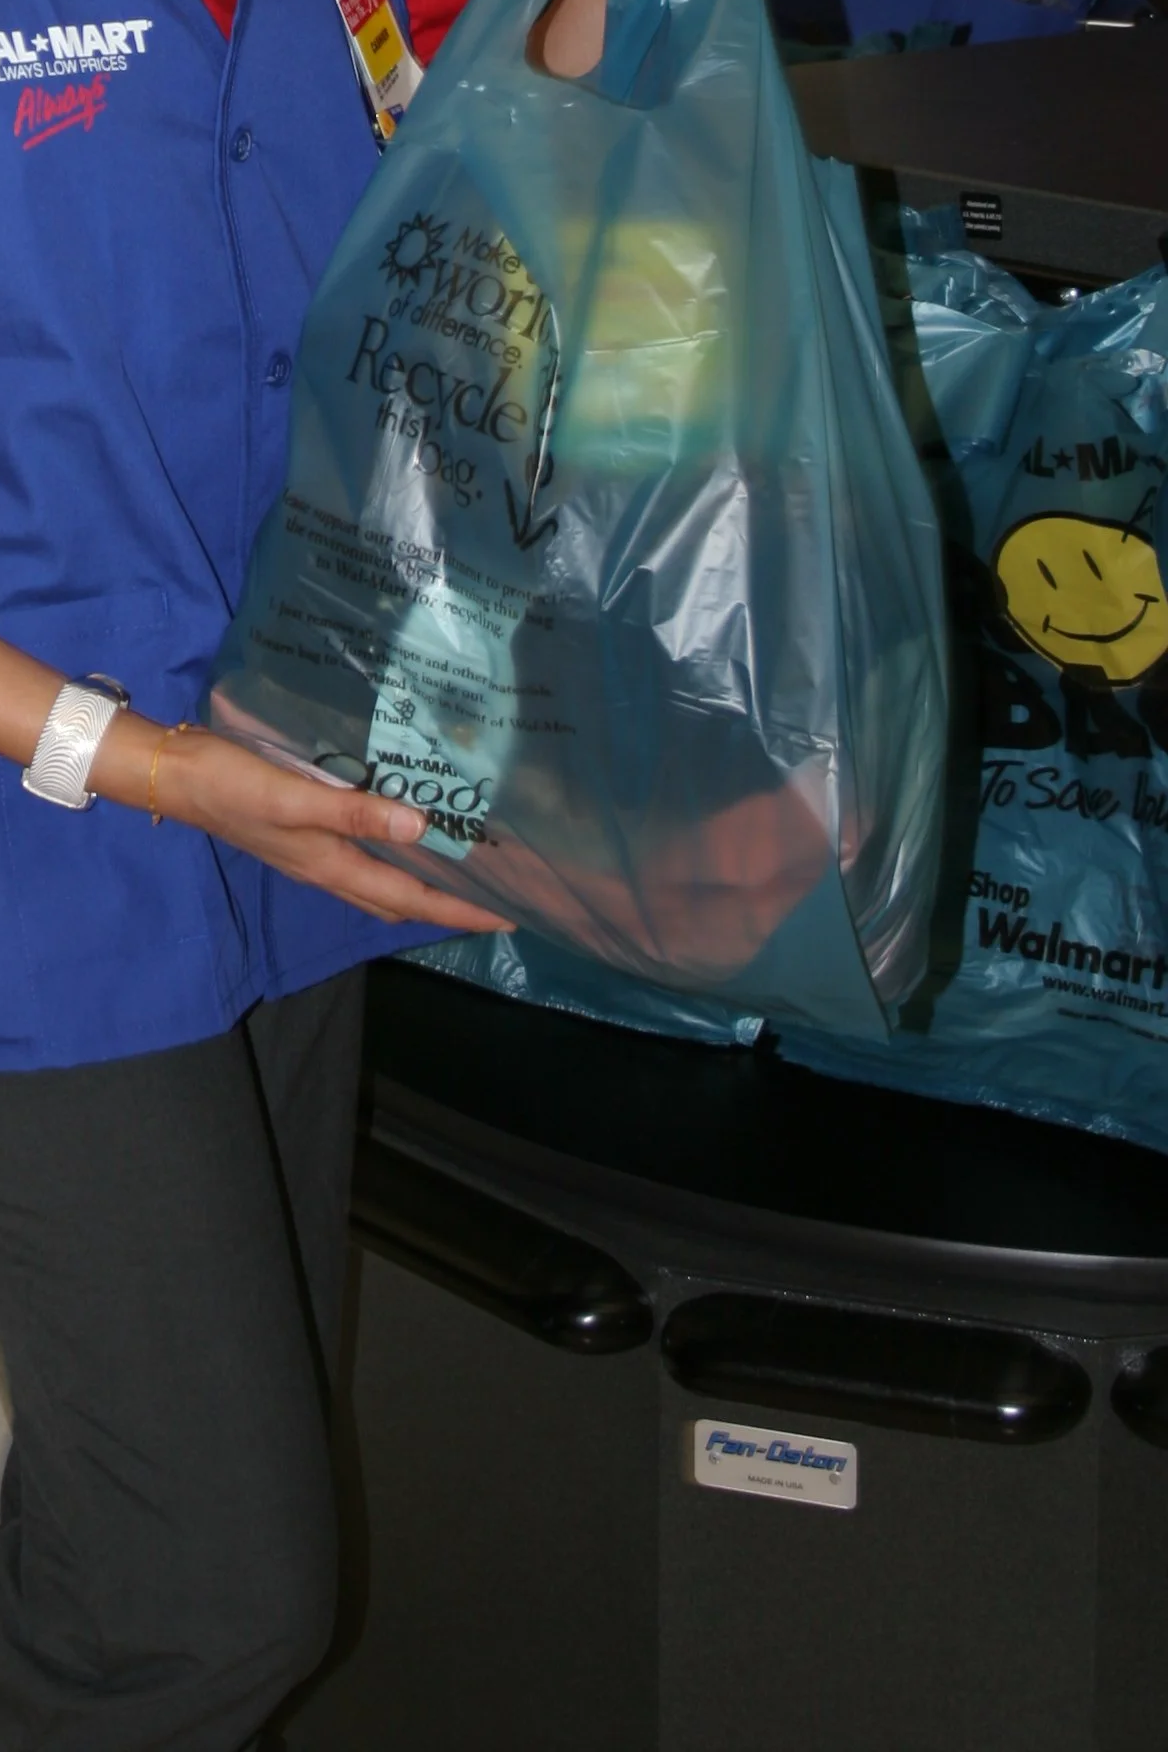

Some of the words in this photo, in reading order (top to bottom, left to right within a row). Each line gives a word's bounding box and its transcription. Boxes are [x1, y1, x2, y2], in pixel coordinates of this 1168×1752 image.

[45, 58, 78, 77] LOW
[80, 55, 127, 73] PRICES
[13, 76, 107, 138] Always
[453, 226, 523, 275] Make
[388, 290, 415, 318] of
[410, 302, 524, 369] difference.
[345, 314, 529, 443] Recycle
[376, 401, 424, 439] this
[365, 528, 394, 546] our
[486, 575, 499, 590] to
[494, 599, 519, 621] this
[421, 674, 458, 695] inside
[425, 654, 449, 673] and
[452, 666, 488, 686] other
[490, 715, 505, 728] of
[376, 750, 460, 778] WALMA
[425, 808, 499, 847] RKS.
[968, 870, 1031, 911] Shop
[978, 906, 1168, 990] Walmart
[705, 1430, 848, 1472] Pan-Oston
[747, 1474, 773, 1486] MADE
[775, 1478, 784, 1487] IN
[786, 1480, 805, 1490] USA
